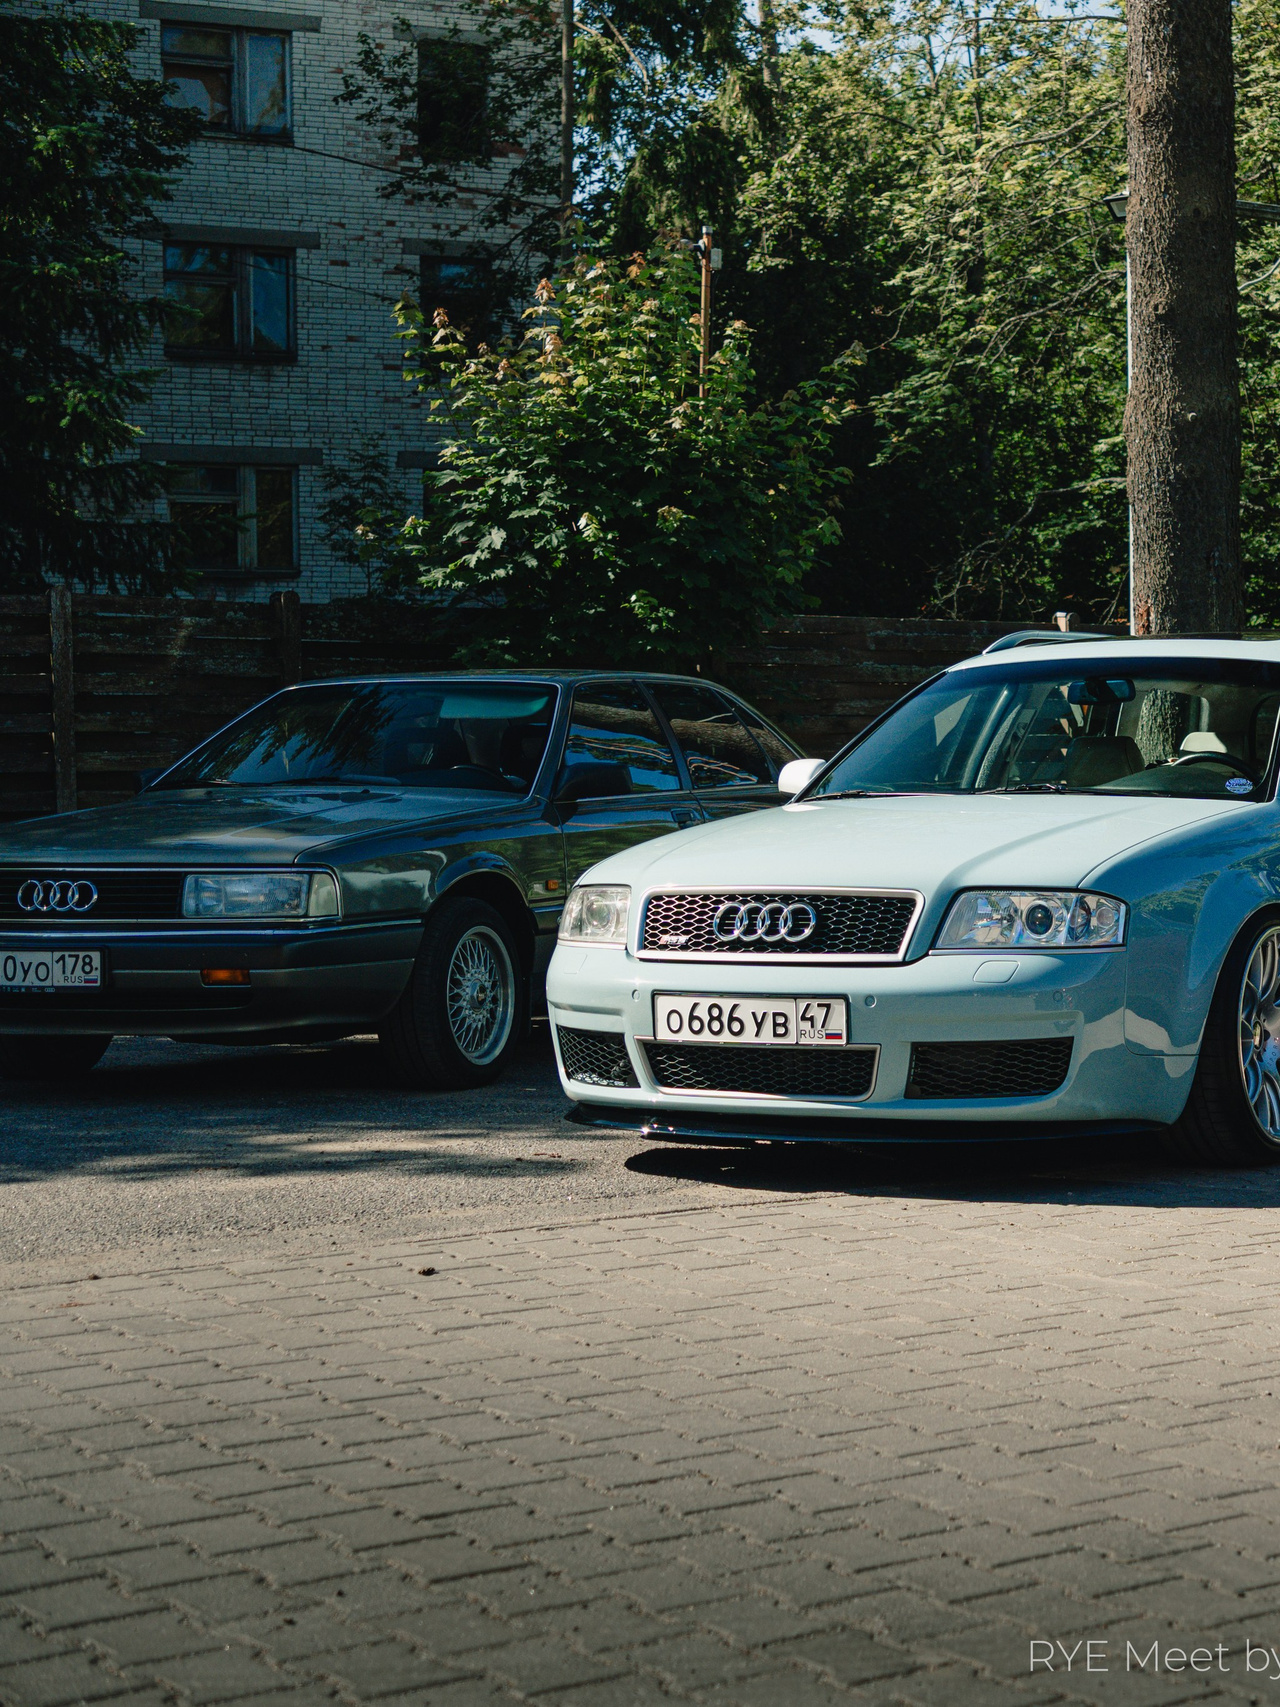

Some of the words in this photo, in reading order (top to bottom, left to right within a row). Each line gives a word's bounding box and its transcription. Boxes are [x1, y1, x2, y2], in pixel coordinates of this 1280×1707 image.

[55, 954, 94, 975] 178
[63, 976, 83, 984] RUS
[666, 1002, 789, 1038] О686УВ
[800, 1003, 832, 1029] 47
[800, 1029, 824, 1039] RUS
